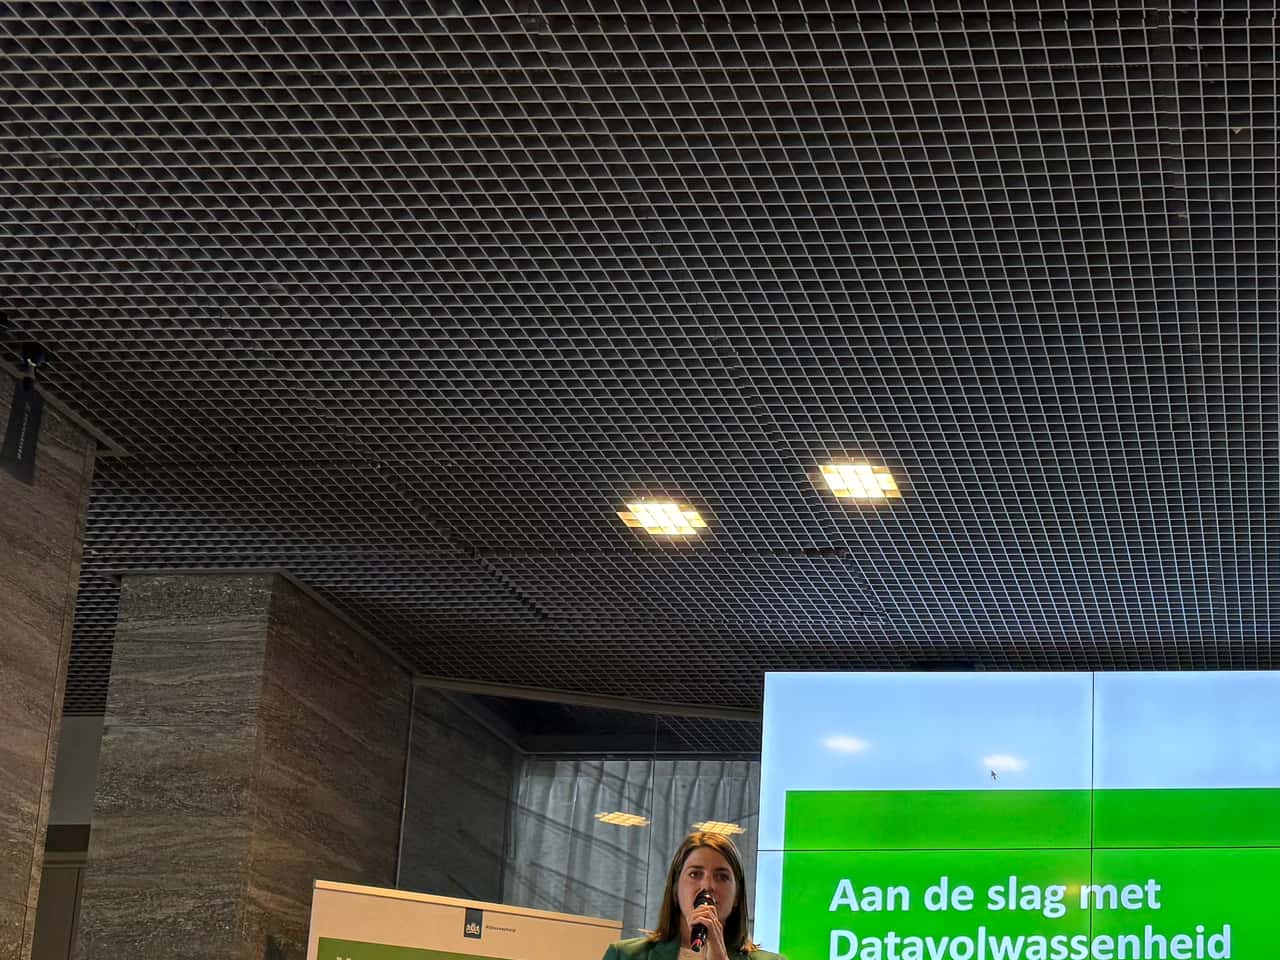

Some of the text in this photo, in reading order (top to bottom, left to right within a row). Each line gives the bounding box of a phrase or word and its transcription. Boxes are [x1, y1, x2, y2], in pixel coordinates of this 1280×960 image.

[828, 876, 1161, 918] Aan de slag met
